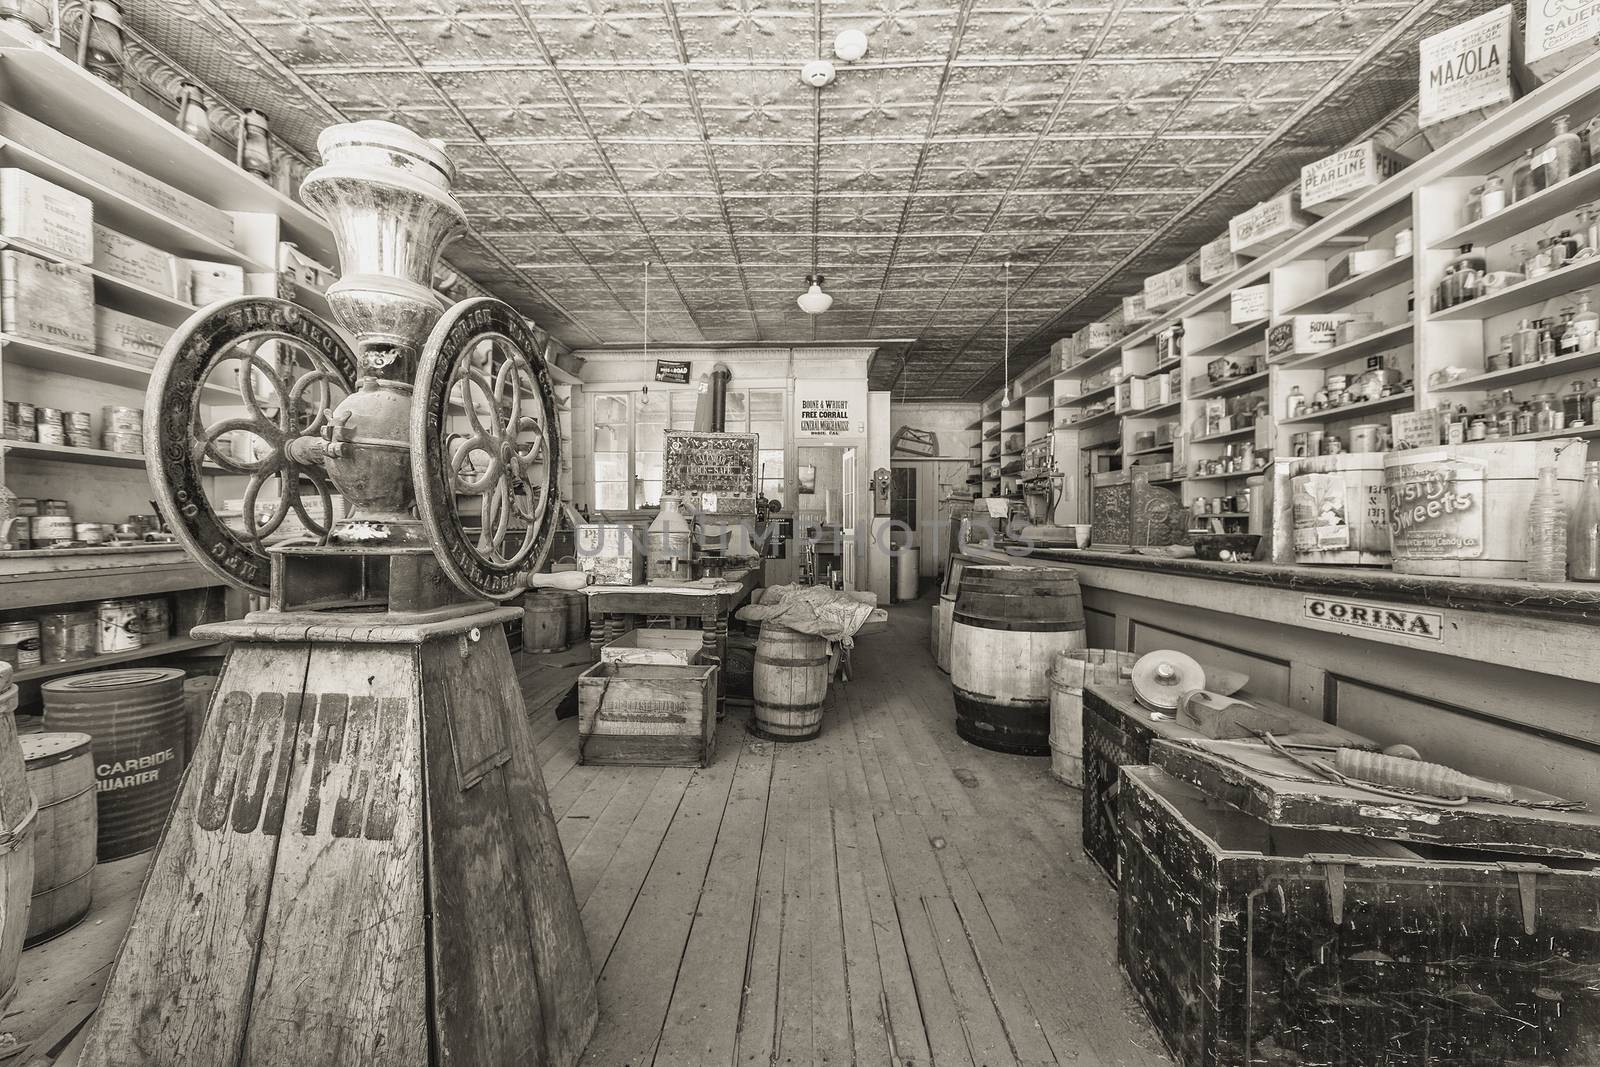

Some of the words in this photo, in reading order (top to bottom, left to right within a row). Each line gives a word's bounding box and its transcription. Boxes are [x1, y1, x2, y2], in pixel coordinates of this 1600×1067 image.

[1430, 44, 1500, 89] MAZOLA
[1305, 158, 1366, 190] PEARLINE
[1310, 321, 1335, 332] ROYAL
[802, 400, 819, 409] BOONE
[825, 400, 848, 409] WRIGHT
[819, 411, 848, 419] CORRALL
[1389, 469, 1451, 512] arsity
[1391, 492, 1473, 535] Sweets
[1437, 538, 1463, 549] Candy
[1309, 601, 1433, 636] CORINA
[96, 747, 175, 777] CARBIDE
